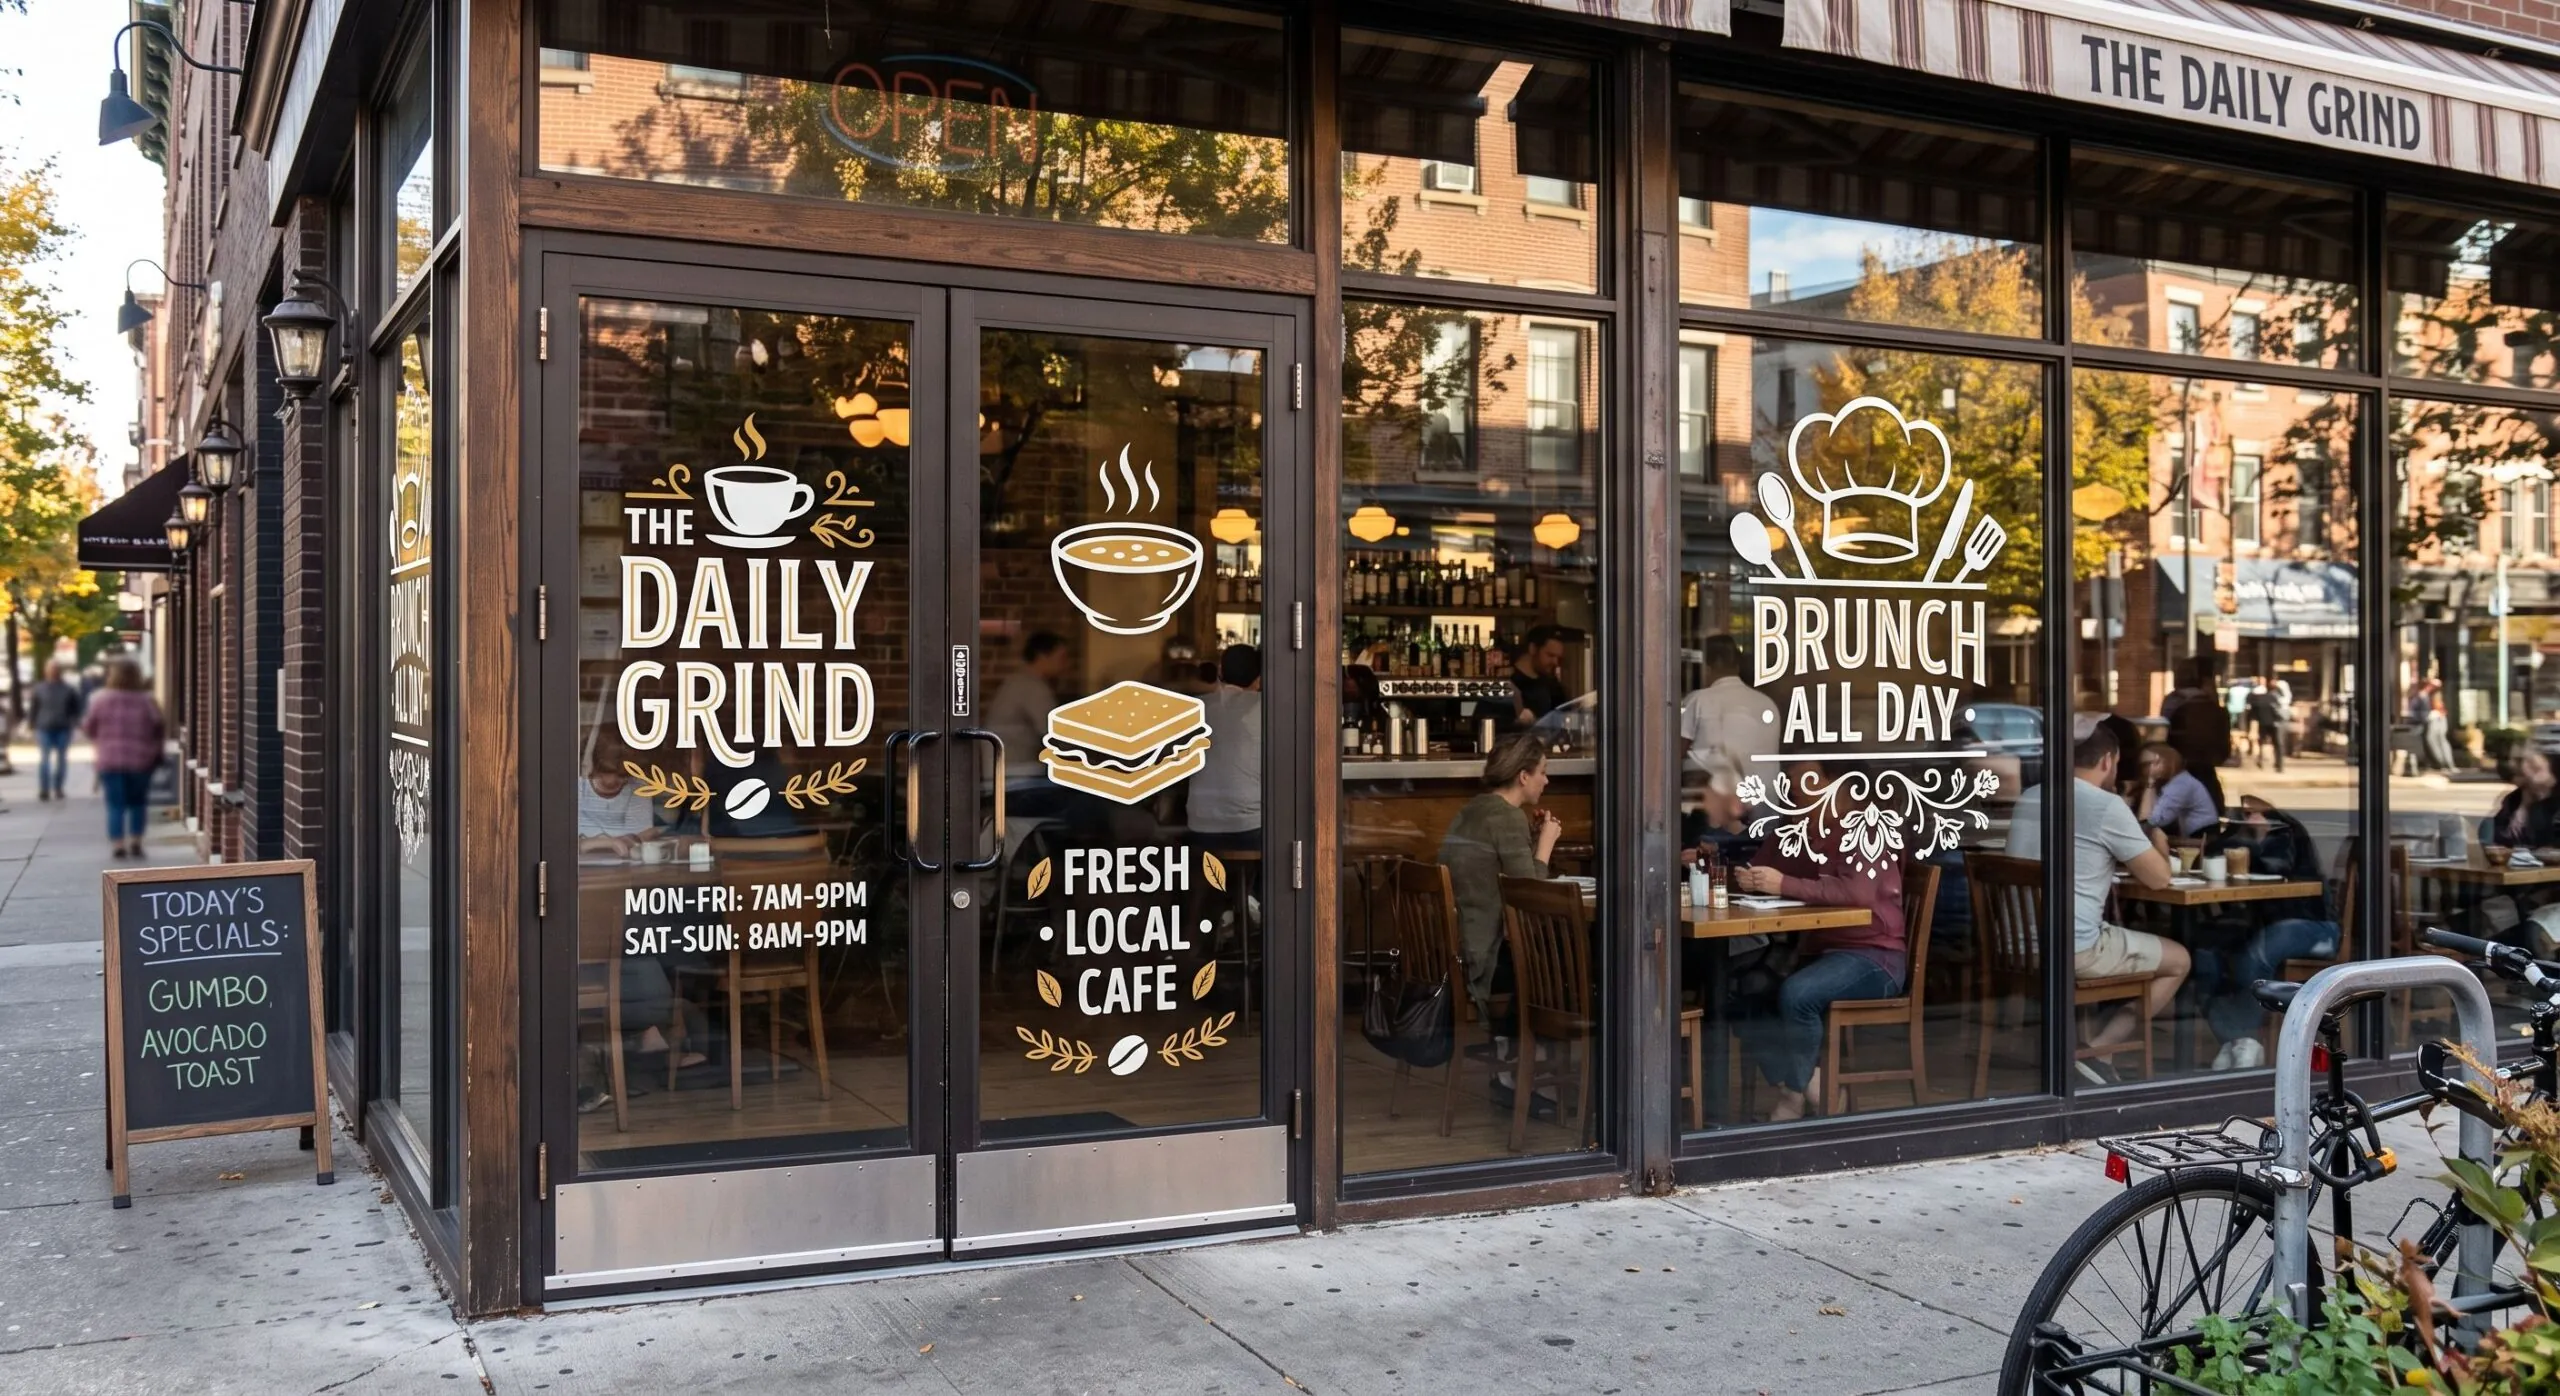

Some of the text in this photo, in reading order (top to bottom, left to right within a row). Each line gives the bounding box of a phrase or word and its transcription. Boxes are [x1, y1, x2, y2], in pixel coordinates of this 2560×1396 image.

[831, 63, 1037, 164] OPEN
[2081, 34, 2420, 151] THE DAILY GRIND
[624, 507, 694, 546] THE
[391, 574, 430, 673] BRUNCH
[620, 556, 874, 650] DAILY
[1753, 595, 1986, 687] BRUNCH
[616, 660, 875, 768] GRIND
[1783, 681, 1959, 743] ALL DAY
[1064, 845, 1190, 895] FRESH
[140, 886, 264, 919] TODAY'S
[624, 880, 867, 916] MON-FRI: 7AM-9PM
[139, 919, 289, 956] SPECIALS:
[624, 918, 867, 955] SAT-SUN: 8AM-9PM
[1066, 905, 1190, 956] LOCAL
[1078, 964, 1177, 1016] CAFE
[140, 1021, 267, 1059] AVOCADO
[166, 1055, 261, 1090] TOAST
